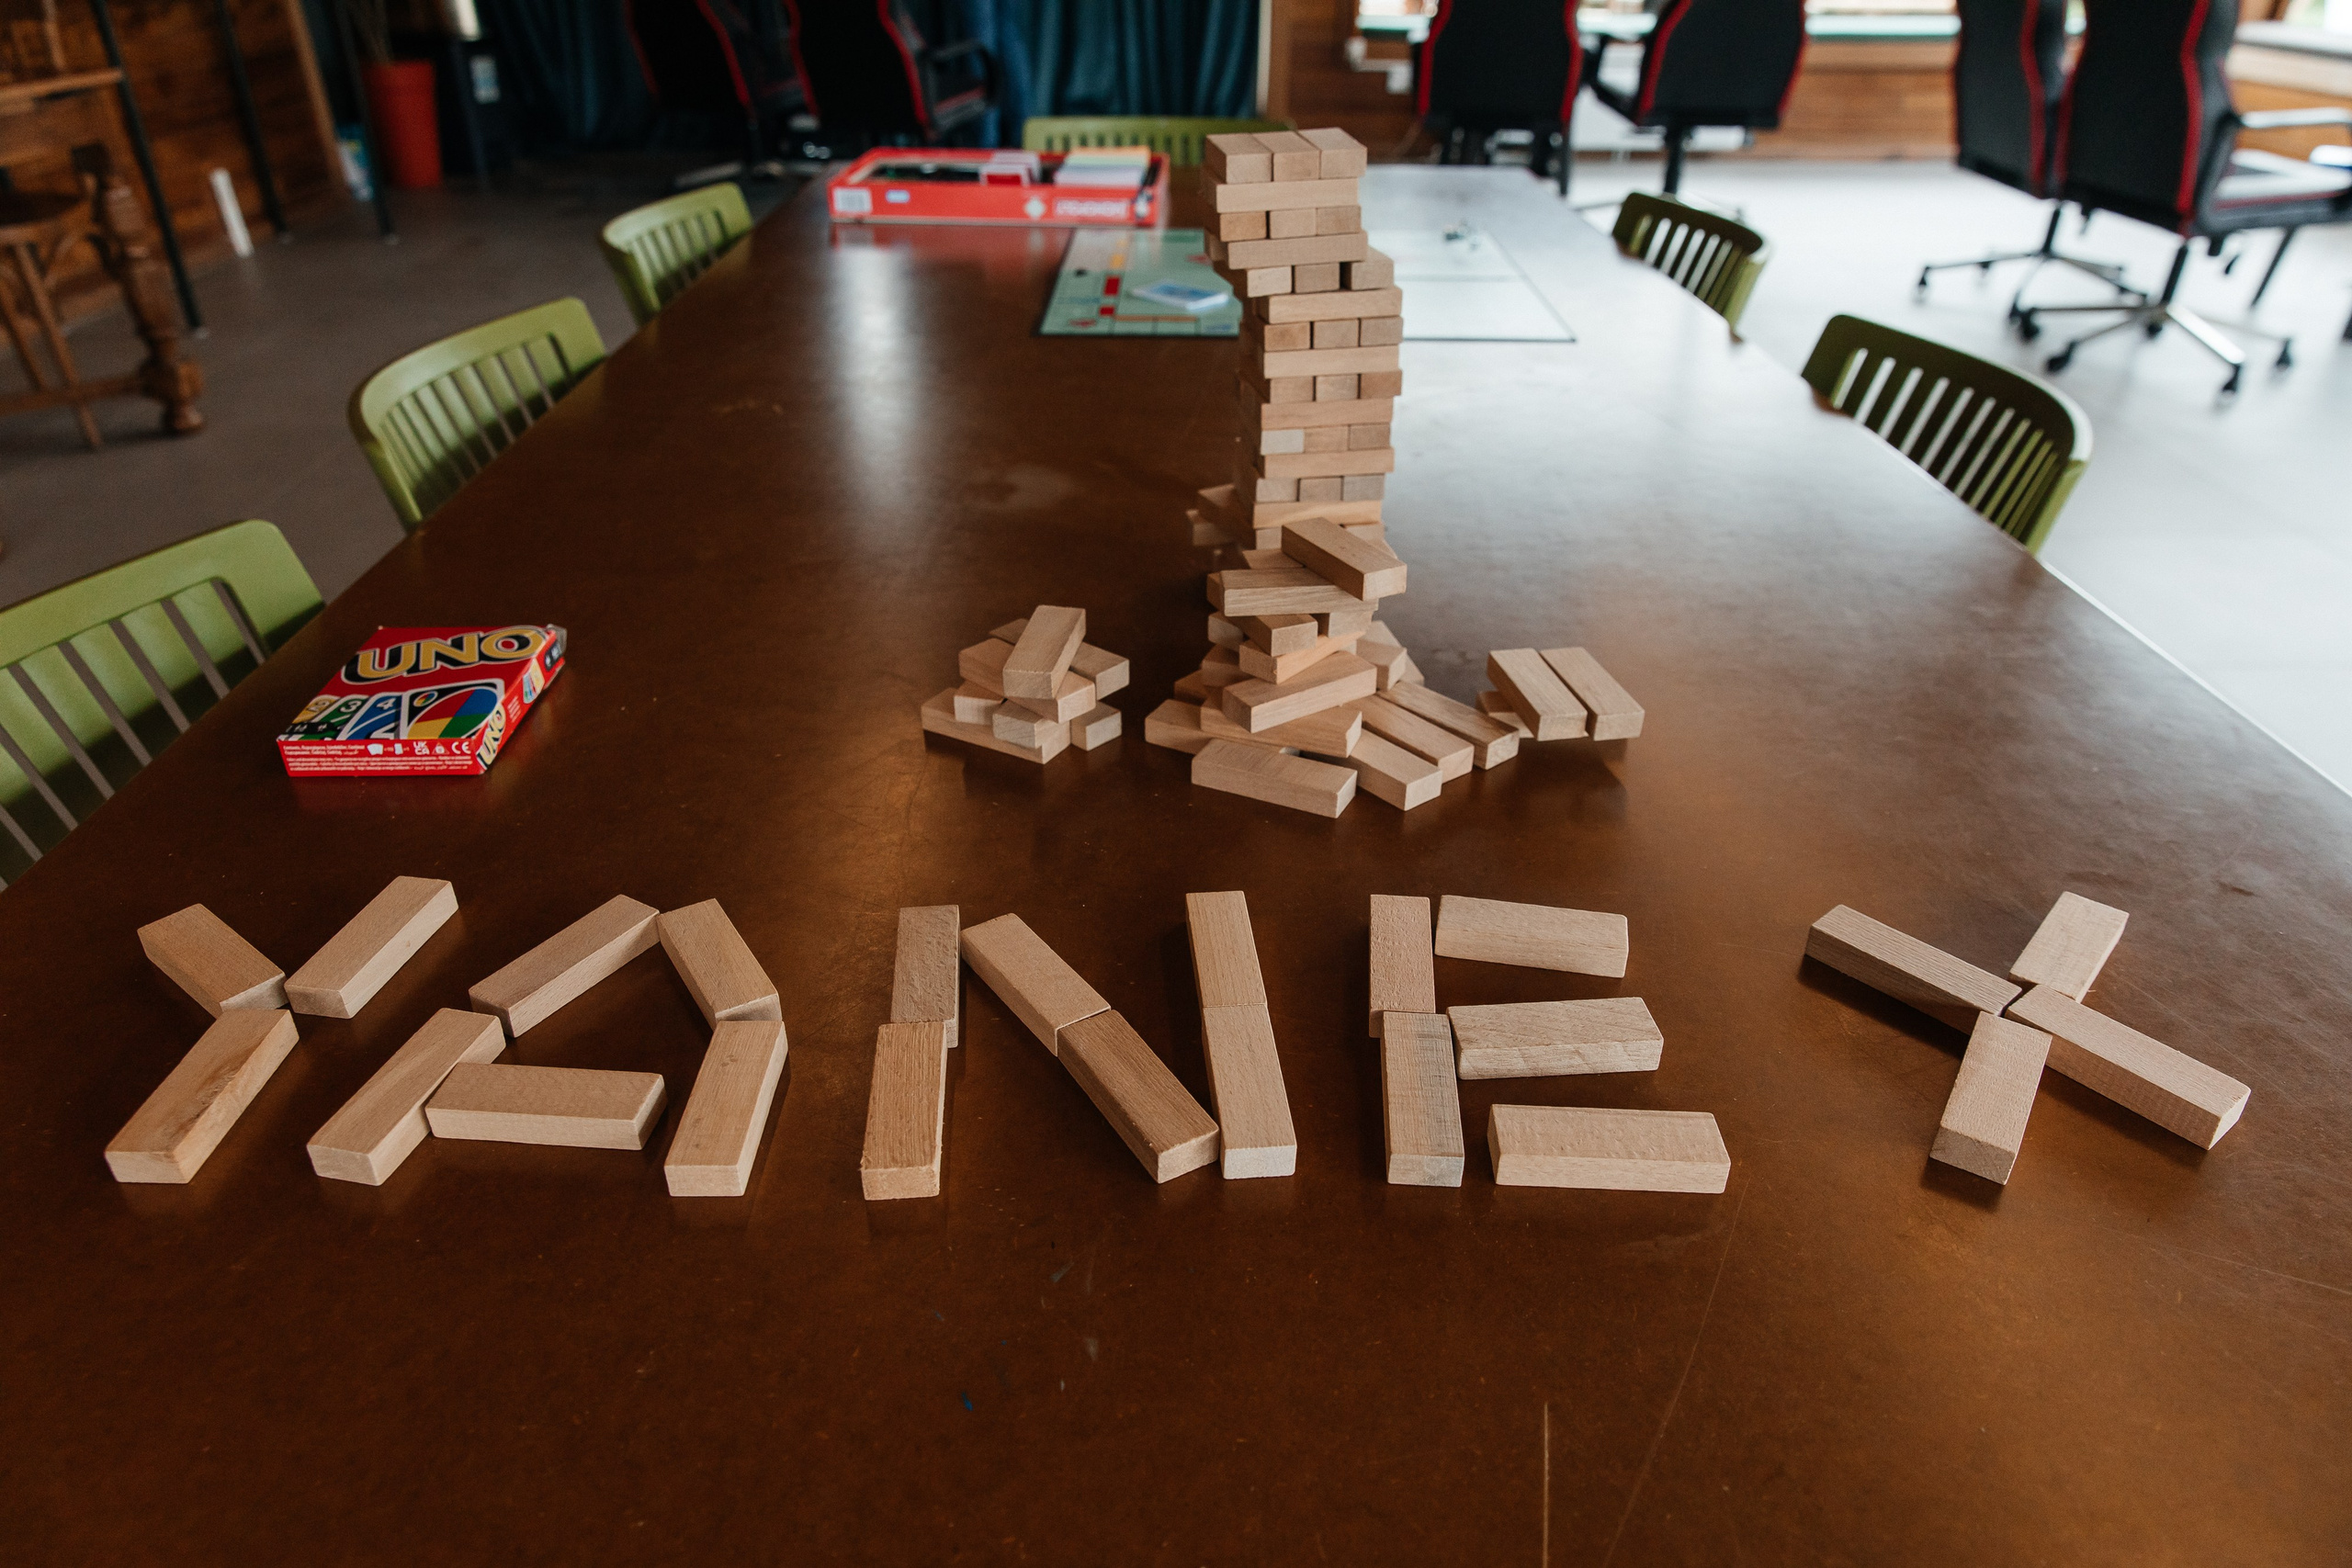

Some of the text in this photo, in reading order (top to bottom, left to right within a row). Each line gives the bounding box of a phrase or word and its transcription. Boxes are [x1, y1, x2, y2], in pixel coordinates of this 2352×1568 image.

[343, 626, 548, 684] UNO
[340, 699, 363, 713] 3
[376, 697, 397, 711] 4
[477, 704, 505, 769] UNO
[451, 741, 471, 755] CE
